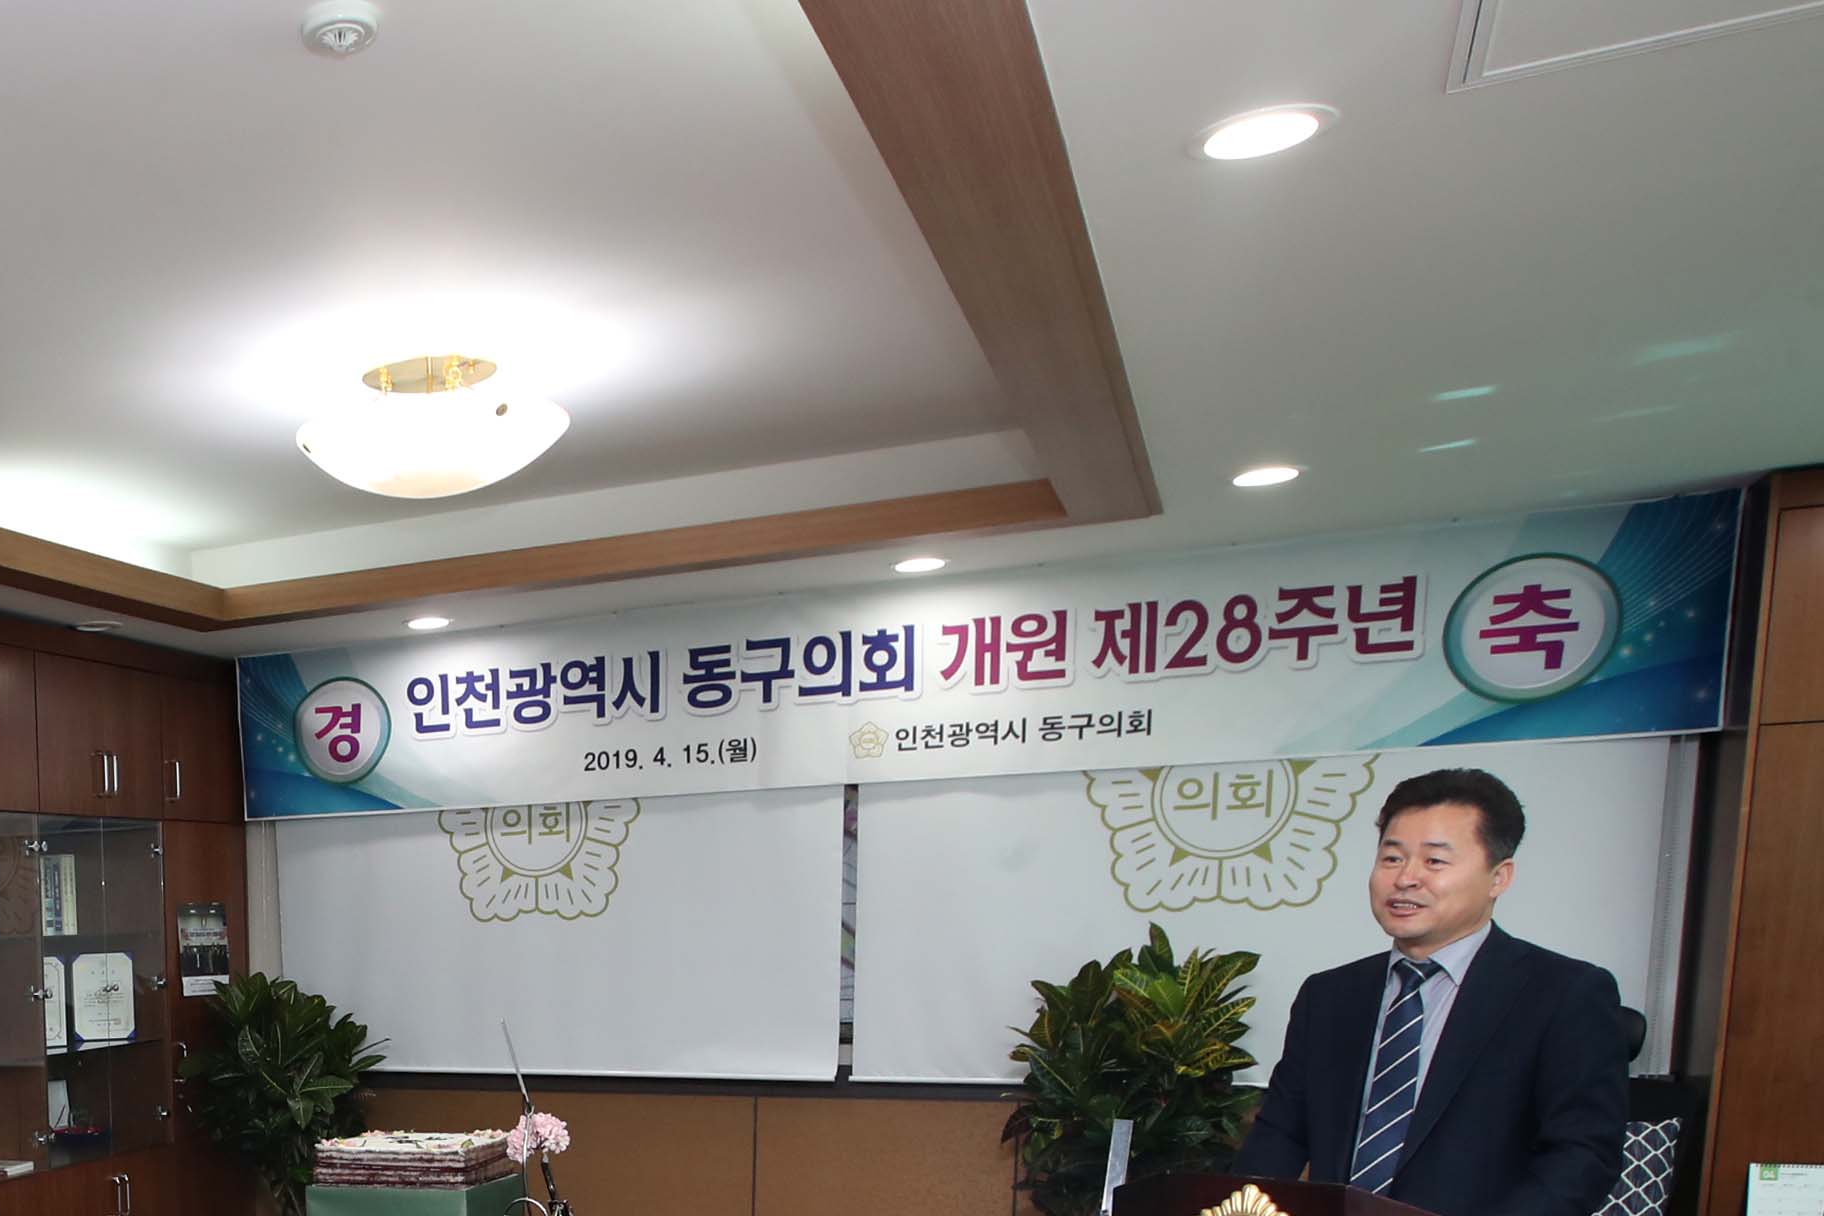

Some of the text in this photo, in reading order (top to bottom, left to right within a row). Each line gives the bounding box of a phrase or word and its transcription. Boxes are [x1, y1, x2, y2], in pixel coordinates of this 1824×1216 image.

[1477, 583, 1580, 671] 축
[406, 573, 1417, 735] 인천광역시 동구의회 개원 제28주년
[315, 703, 363, 763] 경
[583, 735, 758, 773] 2019. 4. 15.(월)
[894, 708, 1154, 754] 인천광역시 동구의회
[1171, 769, 1276, 822] 의회
[500, 804, 573, 845] 의회
